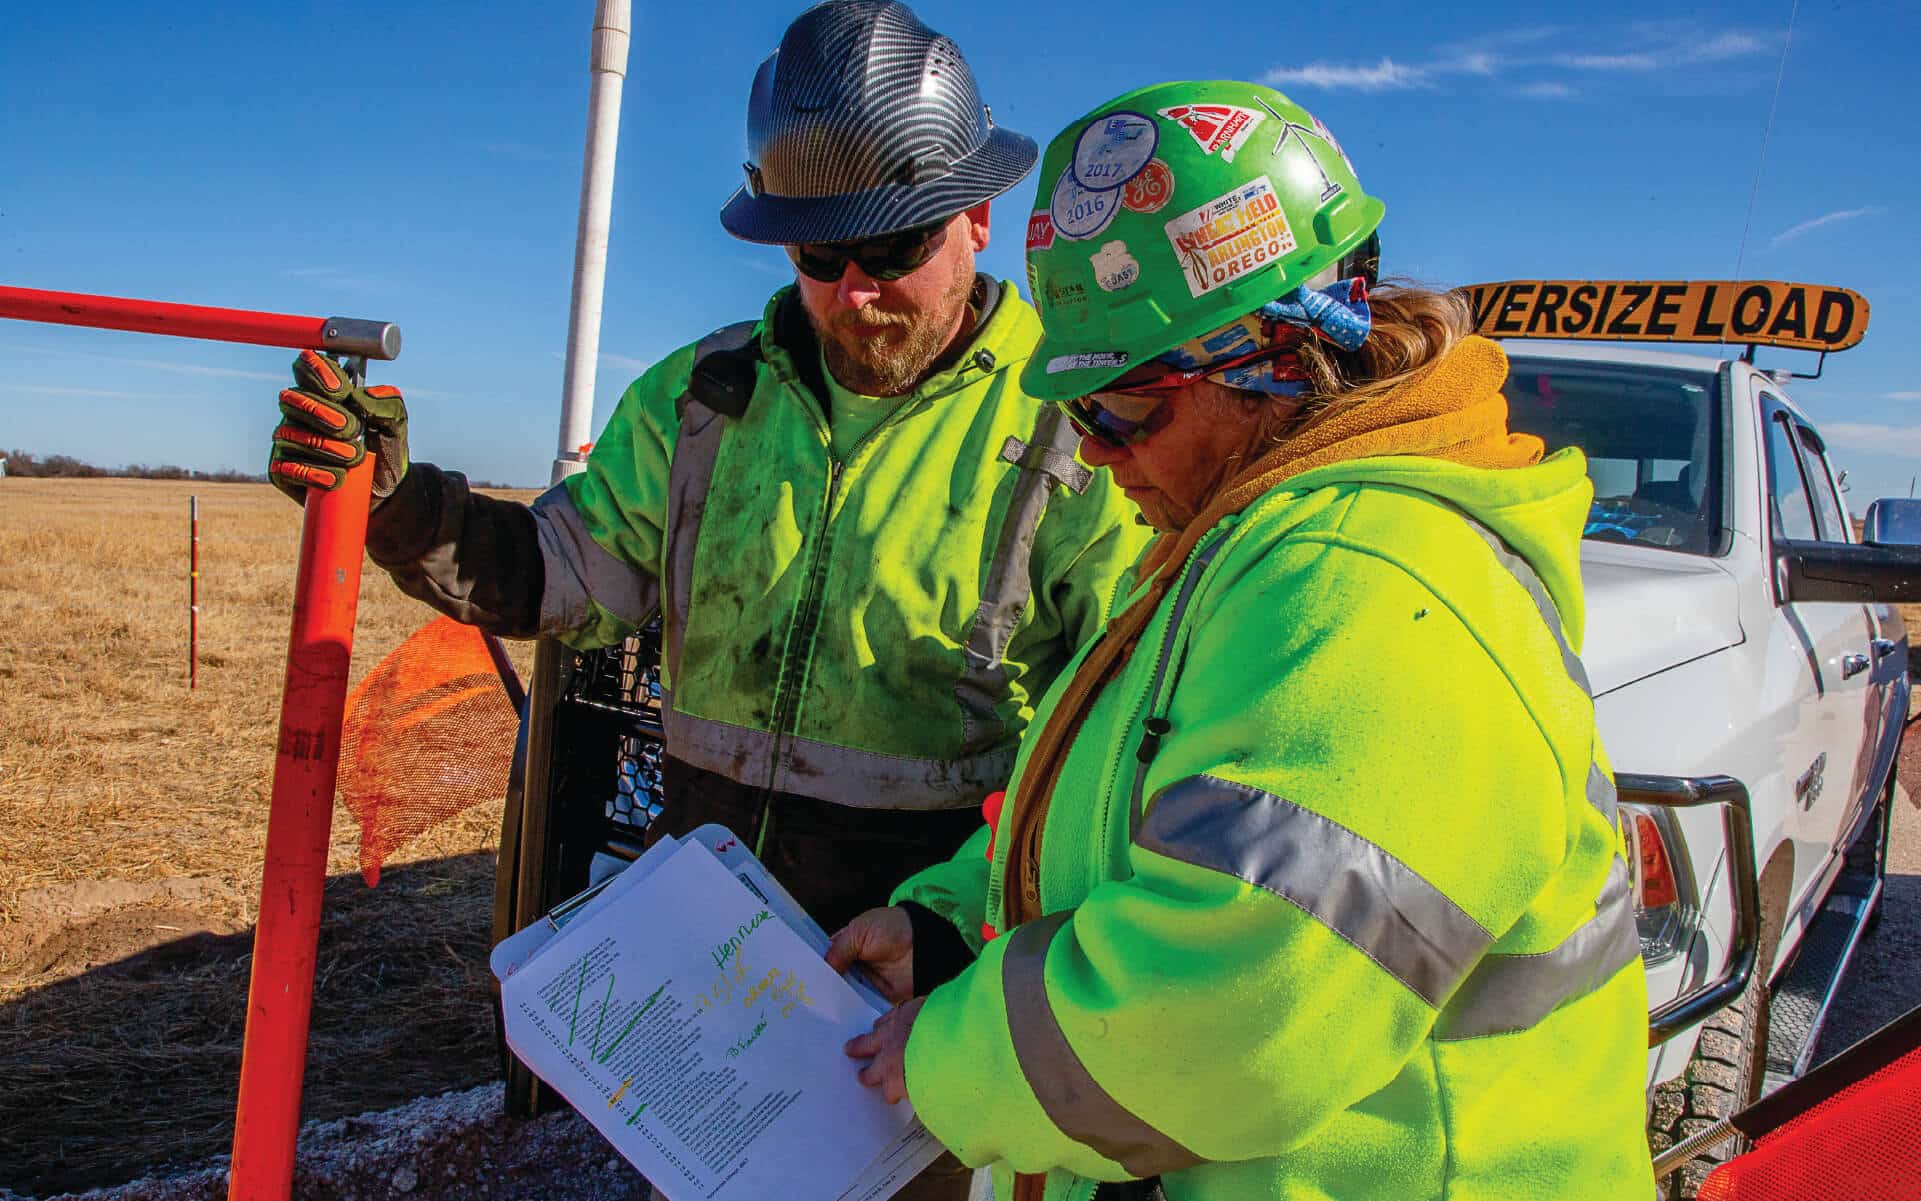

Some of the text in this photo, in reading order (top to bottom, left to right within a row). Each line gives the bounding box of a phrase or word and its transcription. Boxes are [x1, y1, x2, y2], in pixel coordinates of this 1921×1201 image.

[1085, 163, 1122, 178] 2017
[1066, 195, 1105, 224] 2016
[1207, 217, 1287, 268] ARLINGTON
[1472, 284, 1855, 345] VERSIZE LOAD
